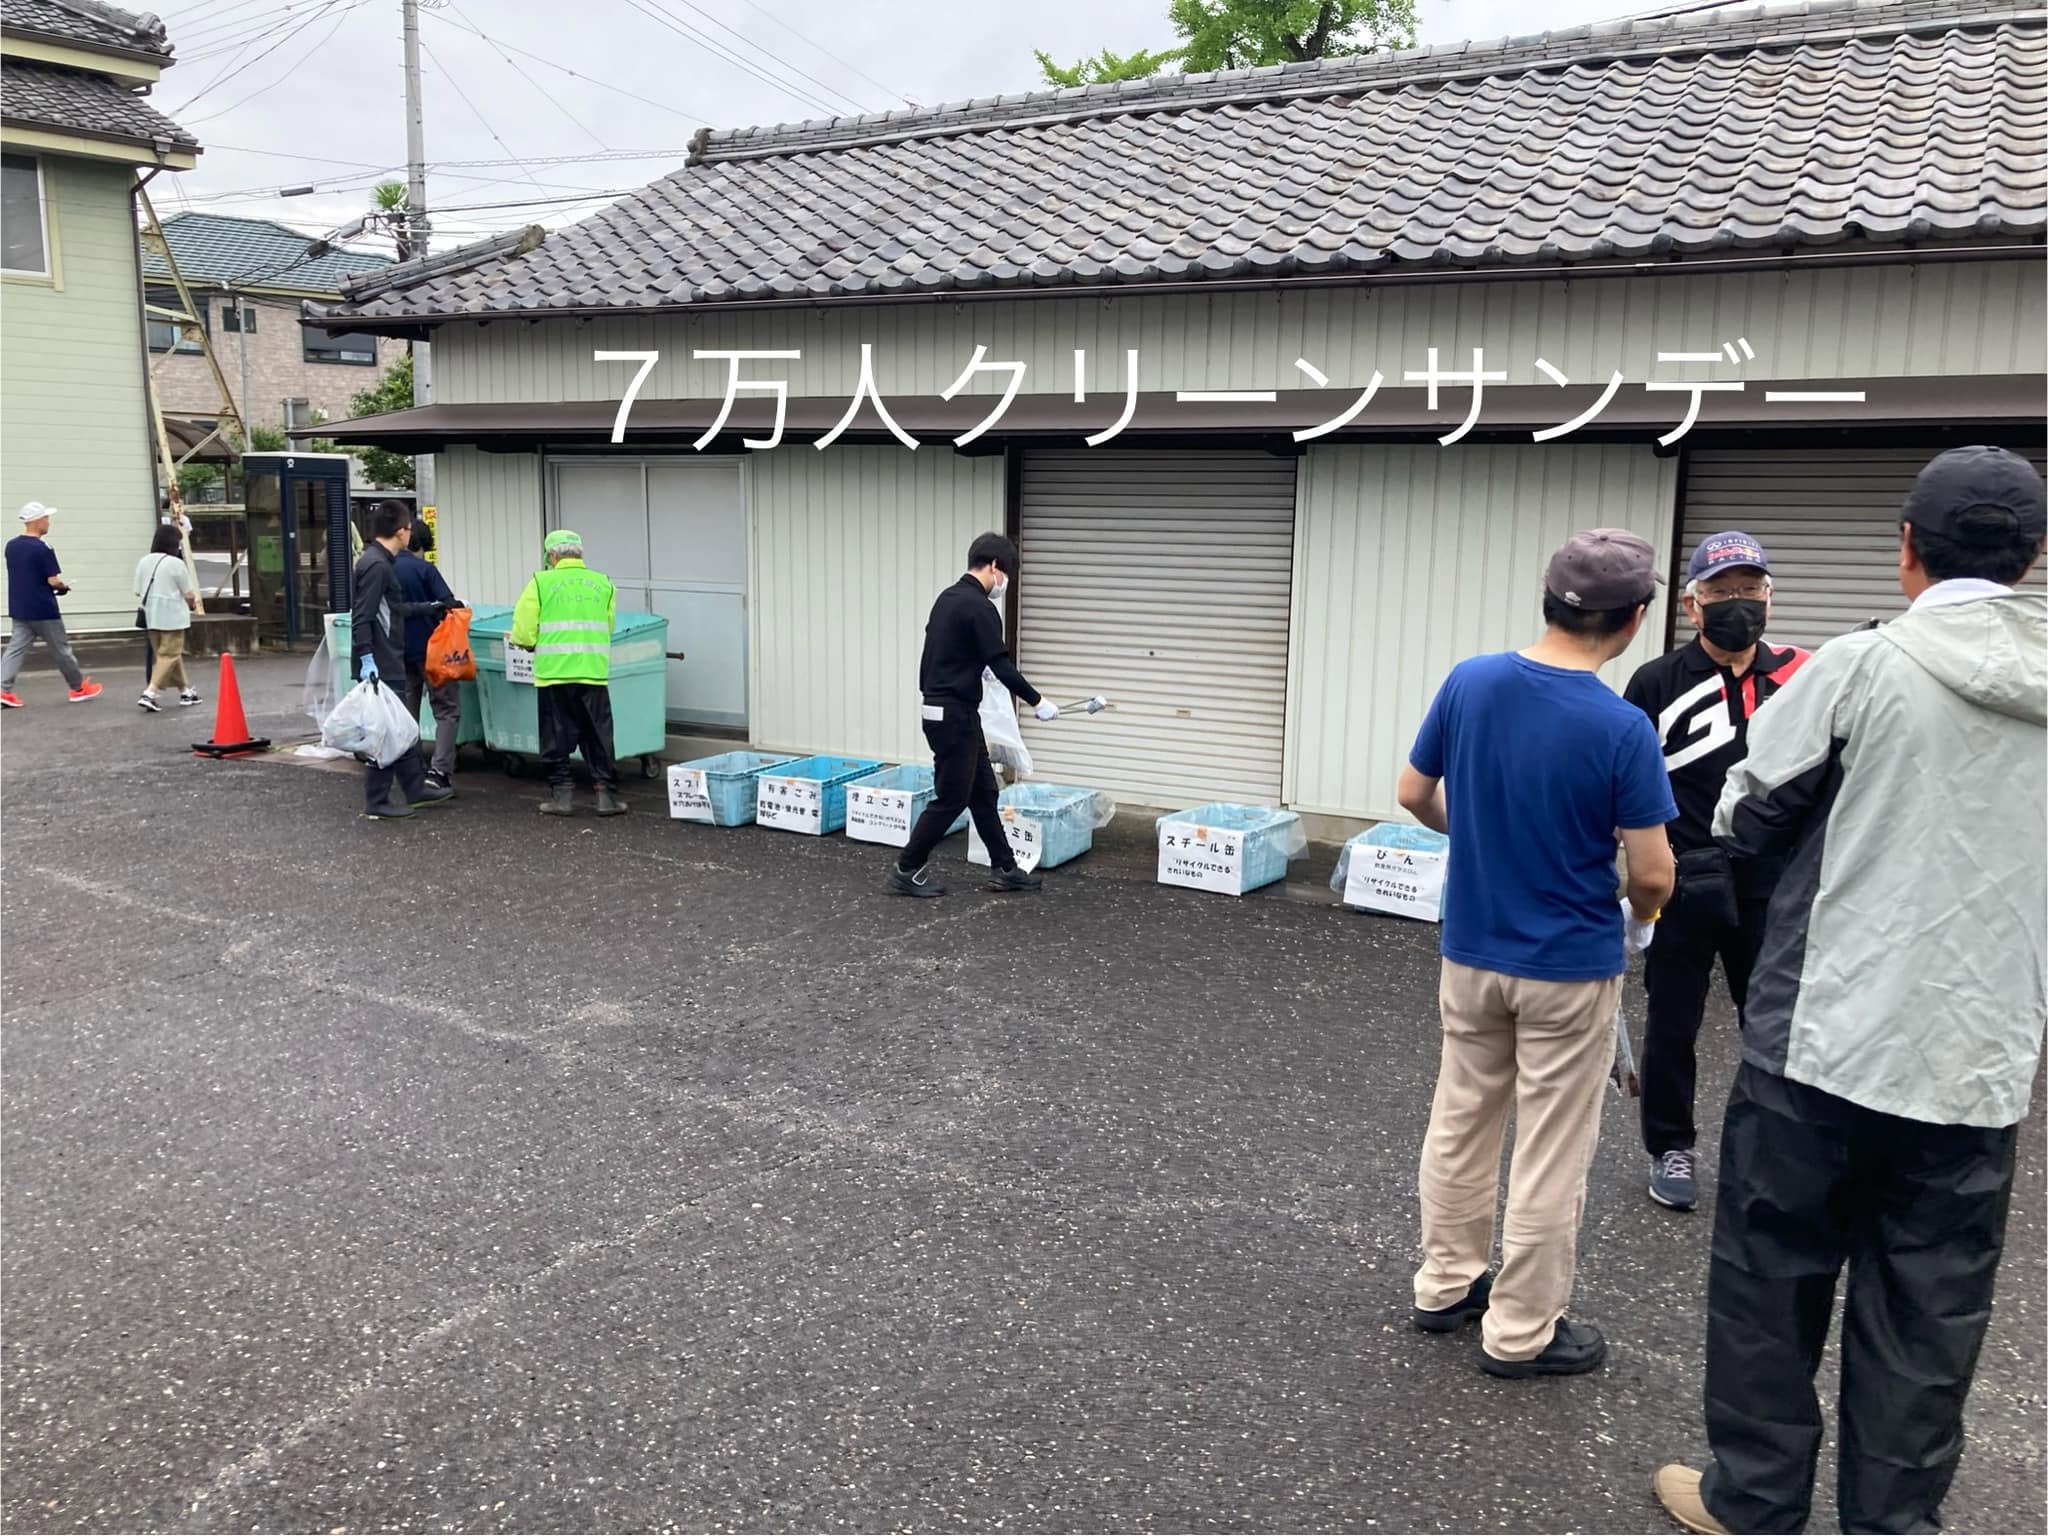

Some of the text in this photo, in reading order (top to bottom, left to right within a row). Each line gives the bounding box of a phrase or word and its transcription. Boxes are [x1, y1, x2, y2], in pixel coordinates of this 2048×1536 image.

[1011, 826, 1034, 843] ミ缶
[1166, 835, 1236, 856] スチール缶
[1376, 849, 1414, 866] びん
